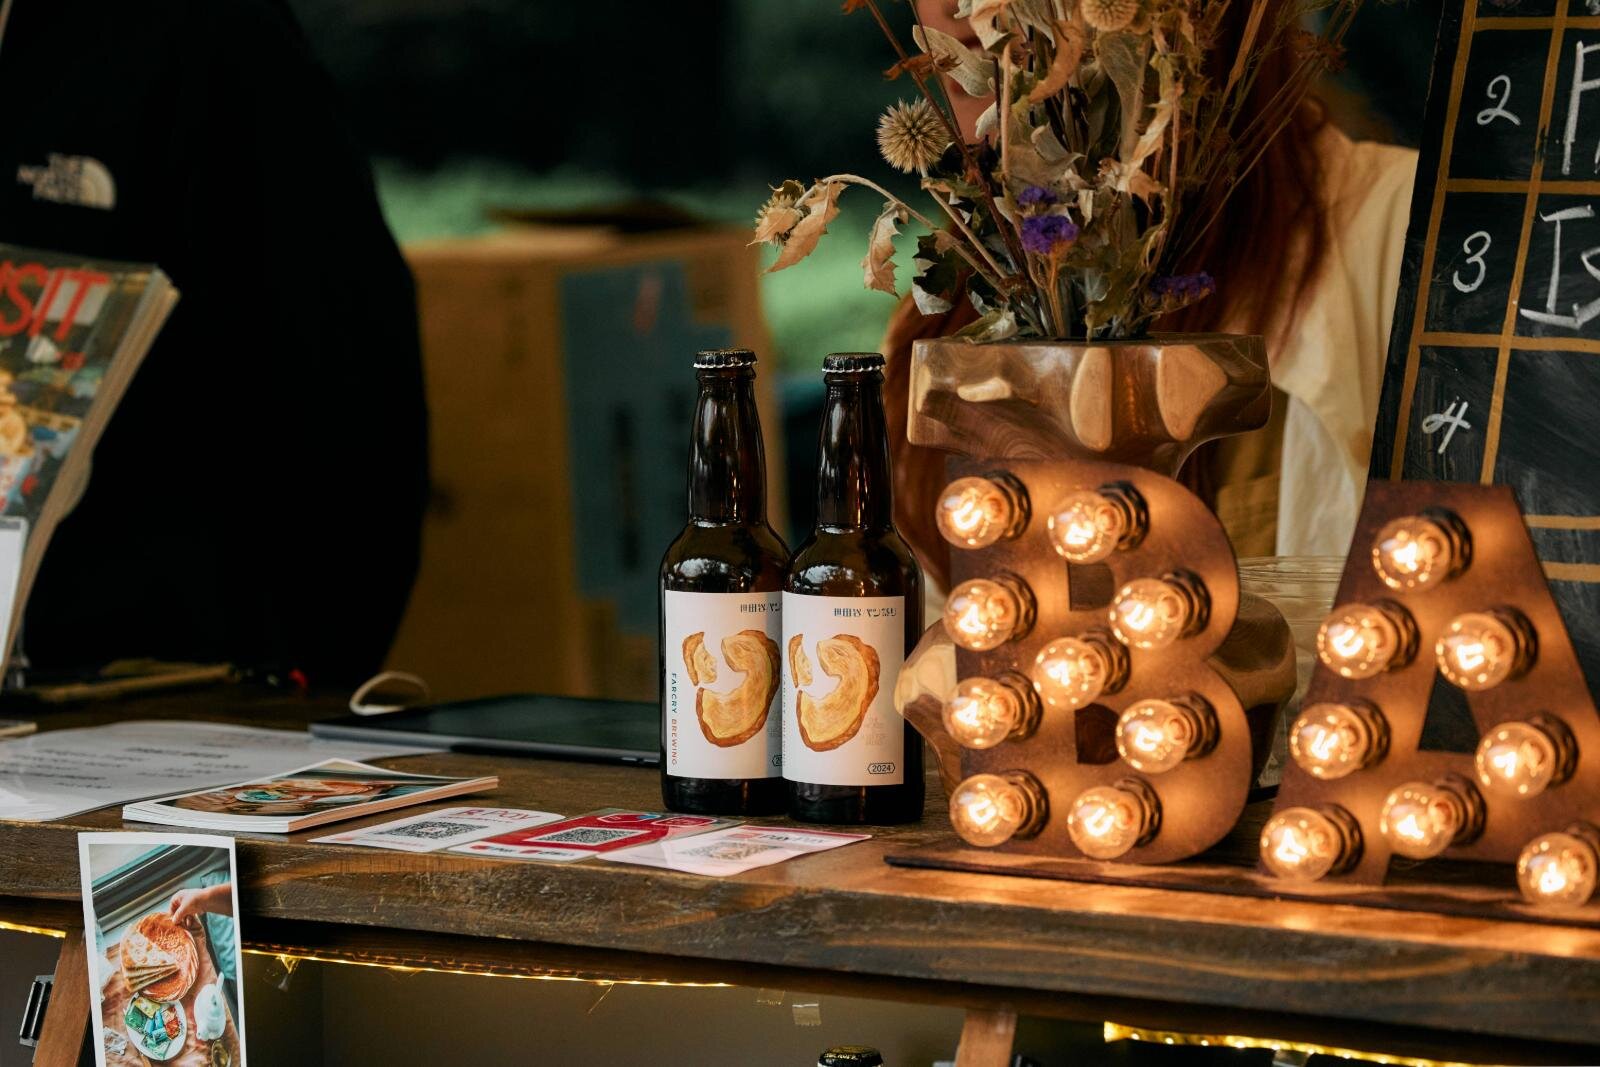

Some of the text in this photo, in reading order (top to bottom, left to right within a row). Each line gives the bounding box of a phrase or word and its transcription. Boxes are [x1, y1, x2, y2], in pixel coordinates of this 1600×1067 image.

[1476, 74, 1521, 126] 2
[1453, 230, 1492, 293] 3
[1422, 400, 1471, 454] 4
[872, 764, 891, 772] 2024
